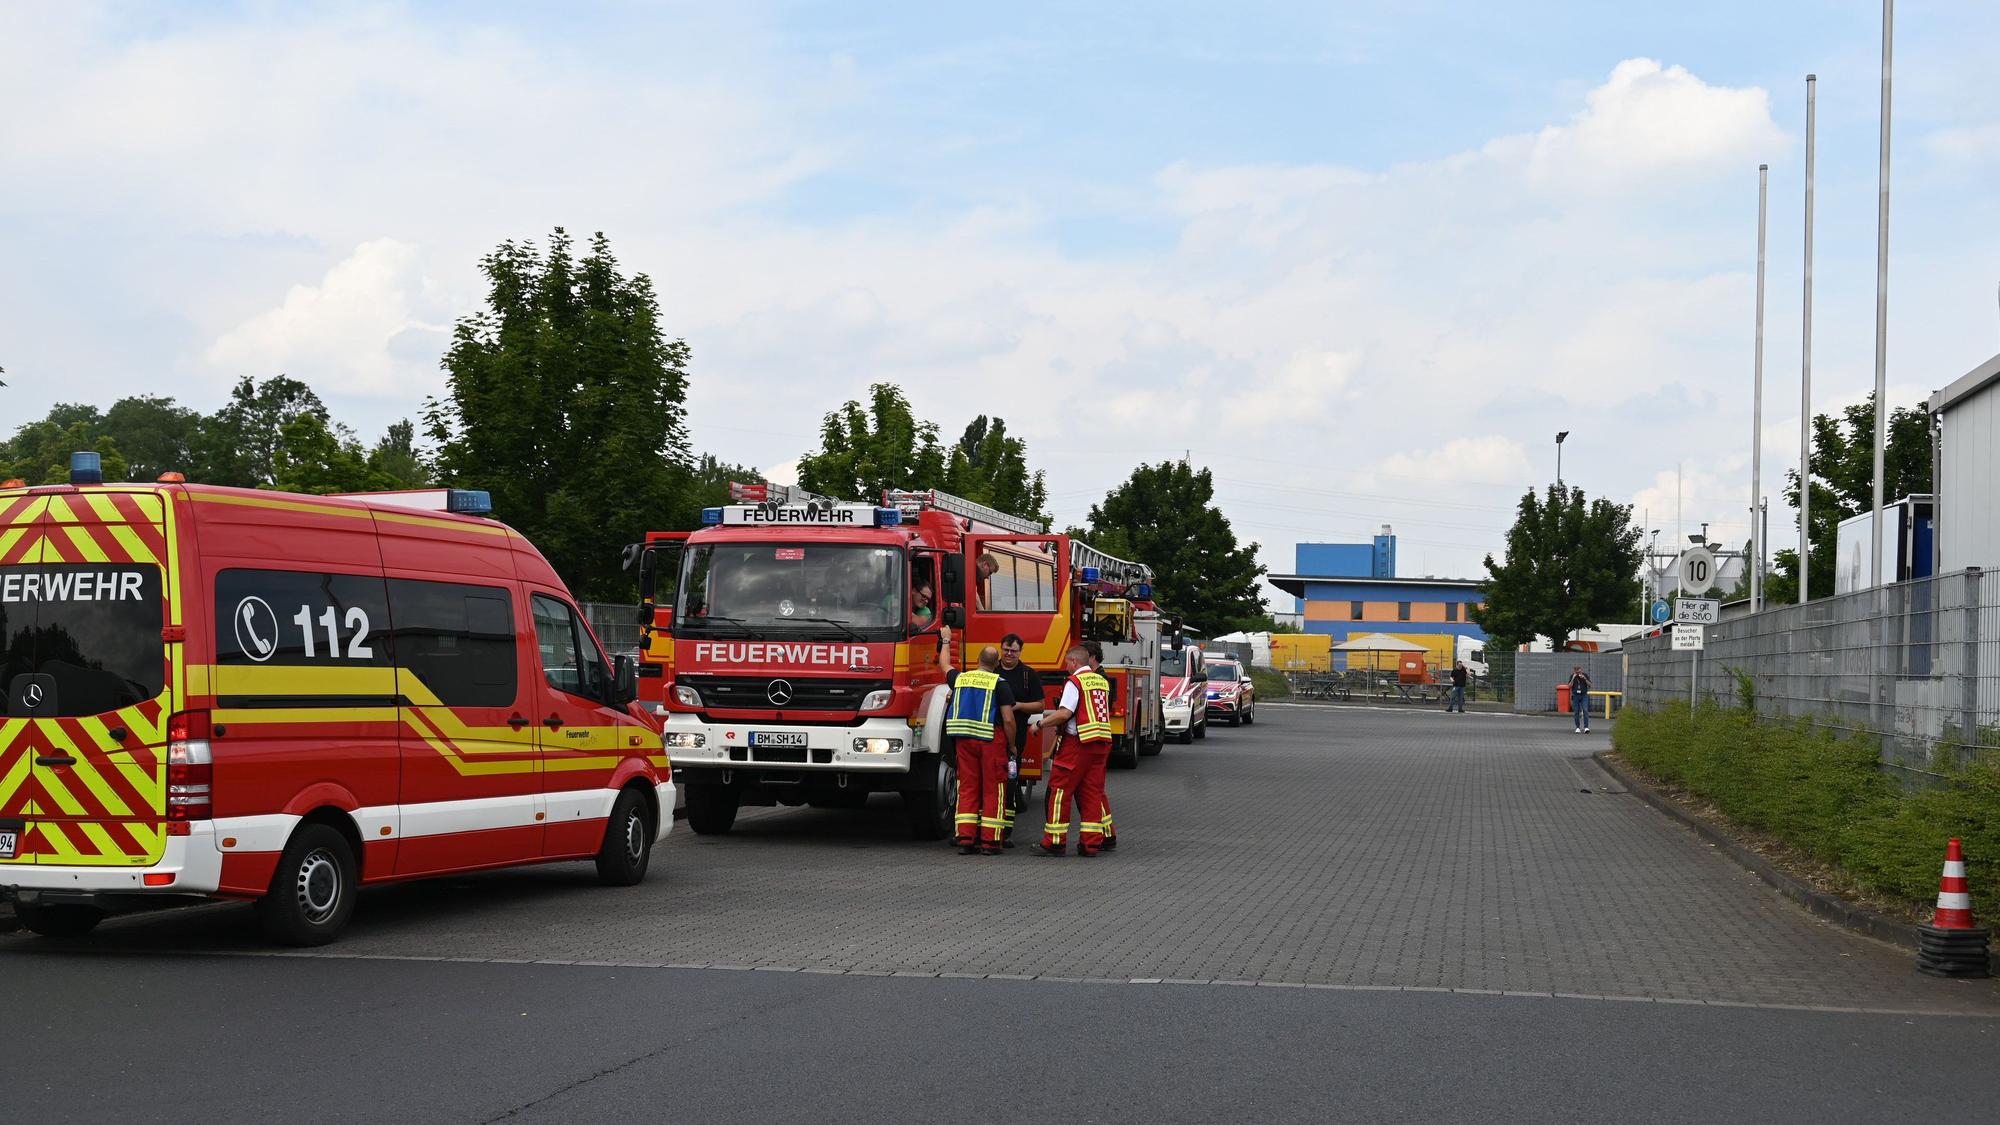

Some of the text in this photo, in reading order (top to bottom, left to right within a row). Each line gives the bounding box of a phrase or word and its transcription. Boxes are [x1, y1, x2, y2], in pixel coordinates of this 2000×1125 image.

[743, 509, 854, 523] FEUERWEHR
[1689, 560, 1707, 581] 10
[0, 572, 143, 602] ERWEHR
[1681, 601, 1710, 612] Hier gilt
[1678, 611, 1712, 621] die StVO
[293, 604, 374, 658] 112
[695, 643, 869, 665] FEUERWEHR
[566, 730, 590, 739] Feuerwehr
[757, 734, 803, 744] BM SH 14
